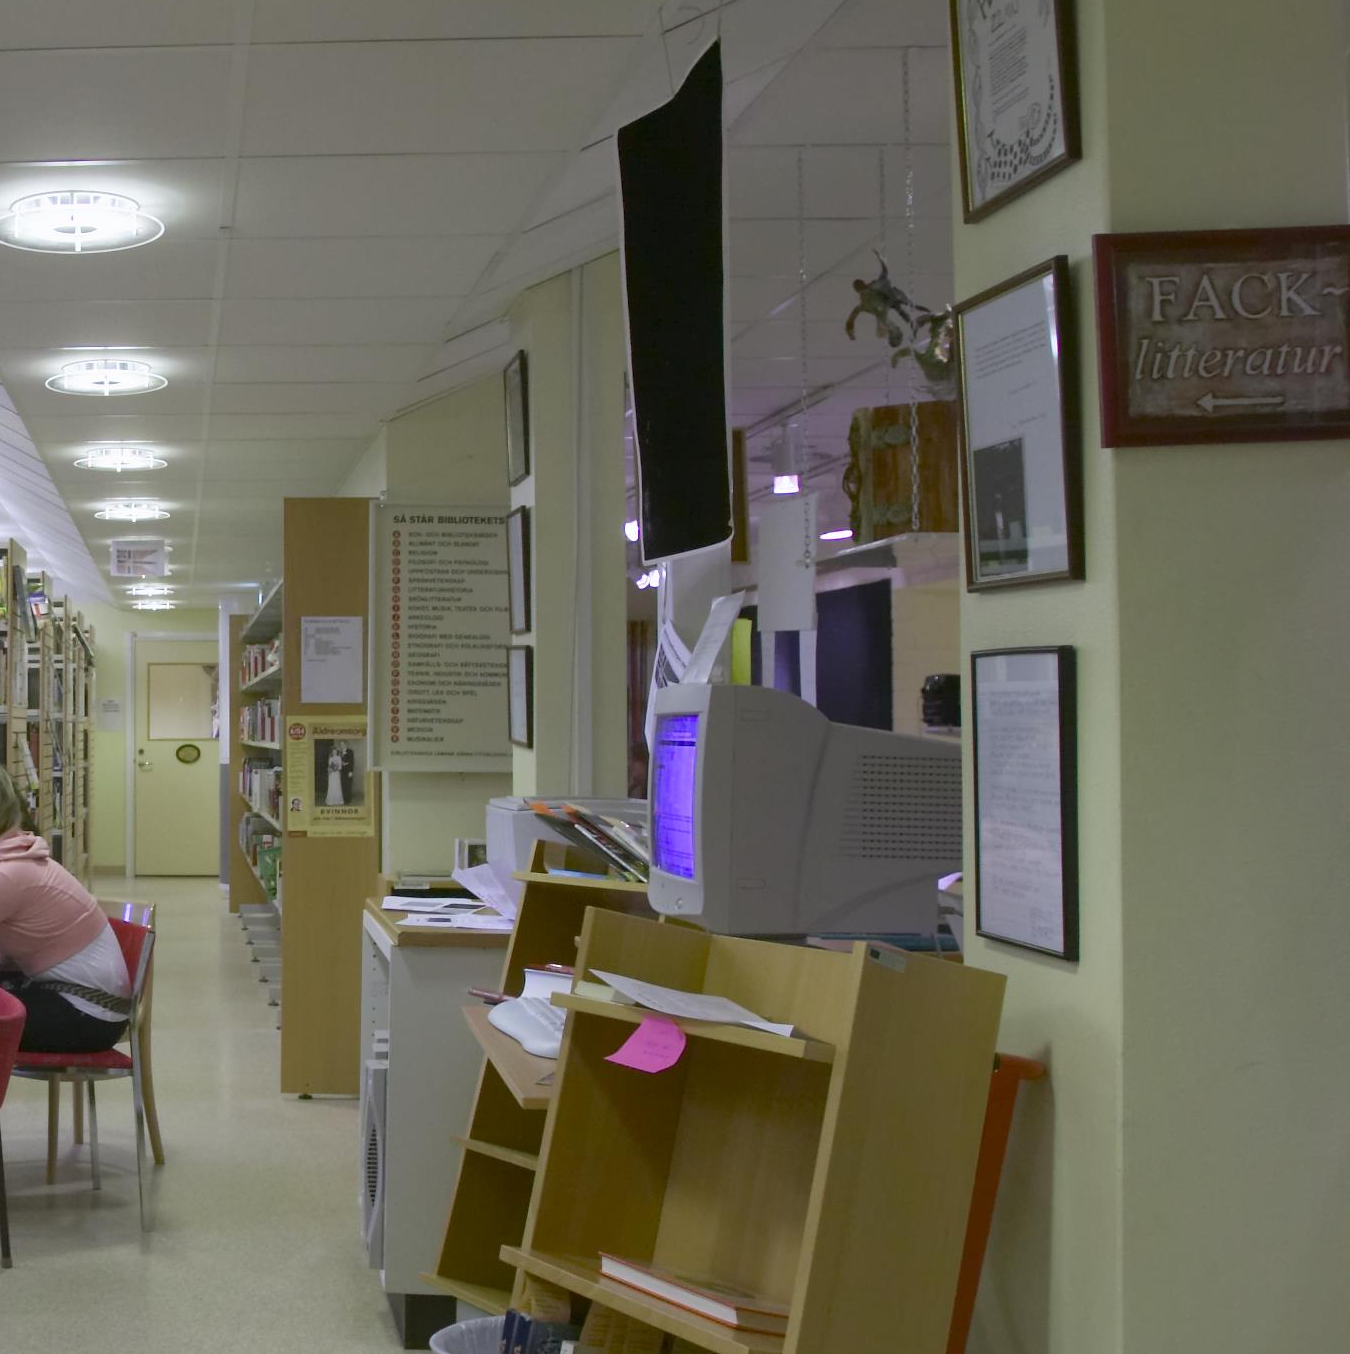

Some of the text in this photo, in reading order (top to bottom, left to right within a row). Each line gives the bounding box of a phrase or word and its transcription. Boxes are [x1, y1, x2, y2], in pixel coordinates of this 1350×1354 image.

[1135, 338, 1343, 380] litteratur
[393, 513, 406, 524] SÅ
[409, 512, 434, 524] STÅR
